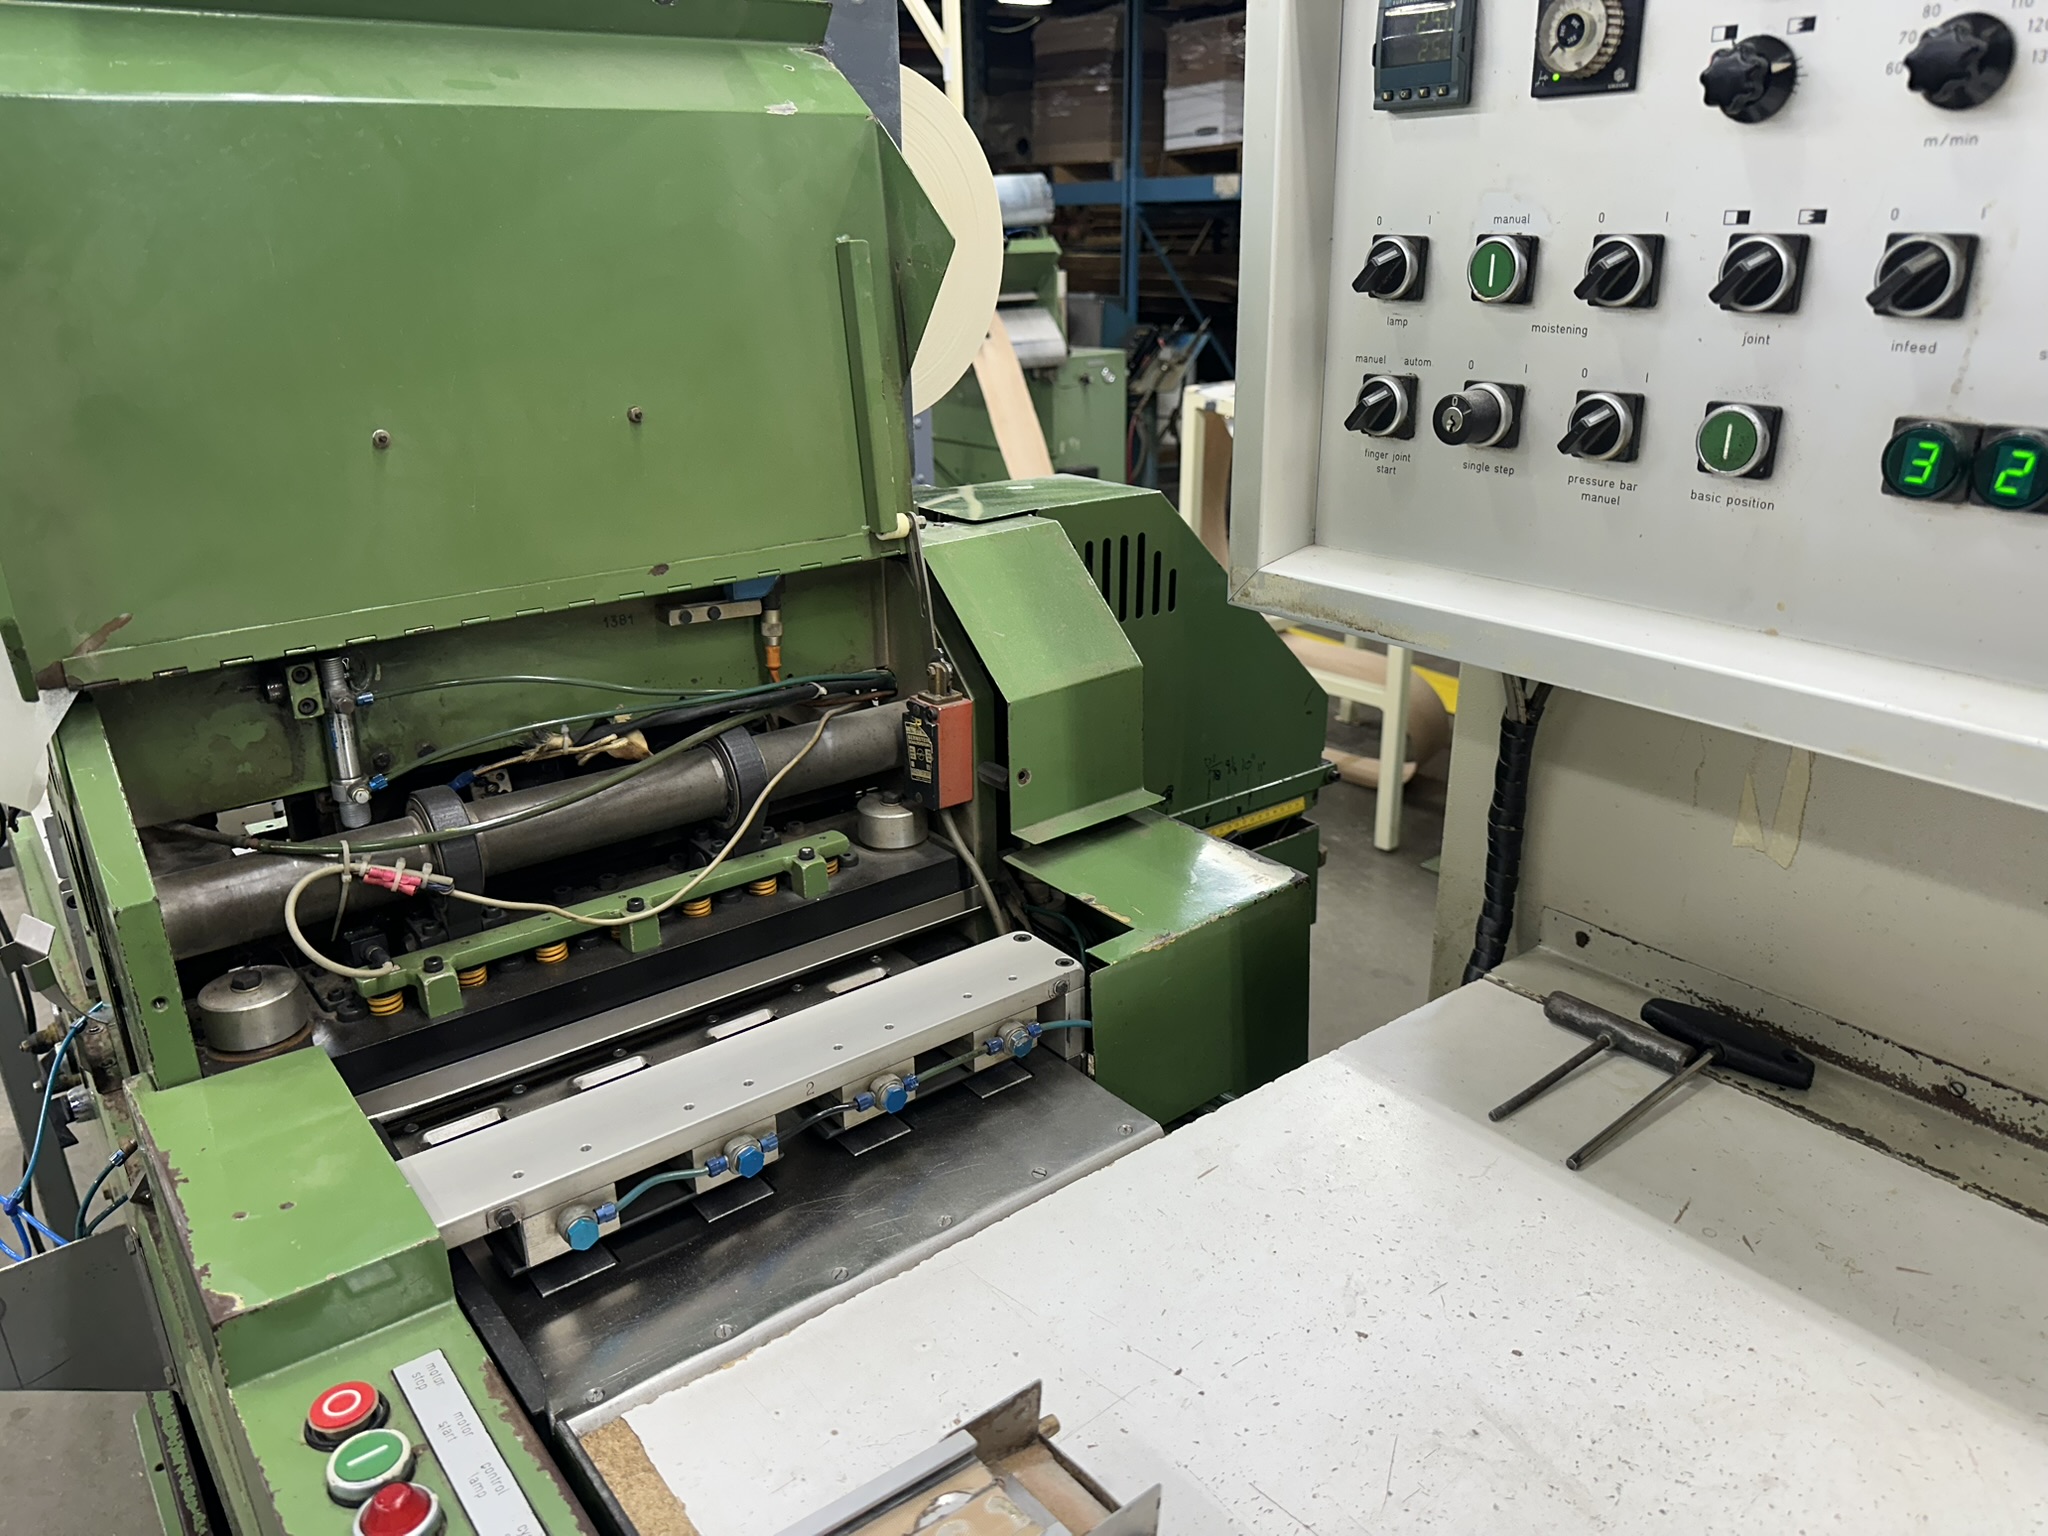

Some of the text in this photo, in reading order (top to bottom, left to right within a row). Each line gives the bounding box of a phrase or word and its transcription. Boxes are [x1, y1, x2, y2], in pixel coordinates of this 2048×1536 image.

[1922, 4, 1942, 19] 80
[1898, 30, 1918, 45] 70
[1885, 61, 1904, 76] 60
[1923, 134, 1979, 147] m/min
[1493, 214, 1531, 225] manual
[1385, 316, 1410, 329] lamp
[1530, 323, 1589, 338] moistening
[1740, 333, 1772, 348] joint
[1891, 340, 1938, 355] infeed
[1355, 356, 1387, 365] manuel
[1364, 449, 1411, 463] finger joint
[1904, 441, 1940, 484] 3
[1376, 466, 1397, 475] start
[1462, 461, 1515, 477] single step
[1994, 449, 2036, 495] 2
[1567, 476, 1638, 492] pressure bar
[1580, 493, 1621, 506] manuel
[1690, 490, 1775, 511] basic position
[602, 614, 634, 628] 1381
[806, 1081, 815, 1097] 2
[411, 1371, 428, 1391] stop
[425, 1362, 446, 1386] motor
[437, 1420, 459, 1443] start
[453, 1411, 474, 1437] motor
[467, 1472, 487, 1498] lamp
[480, 1462, 510, 1496] control
